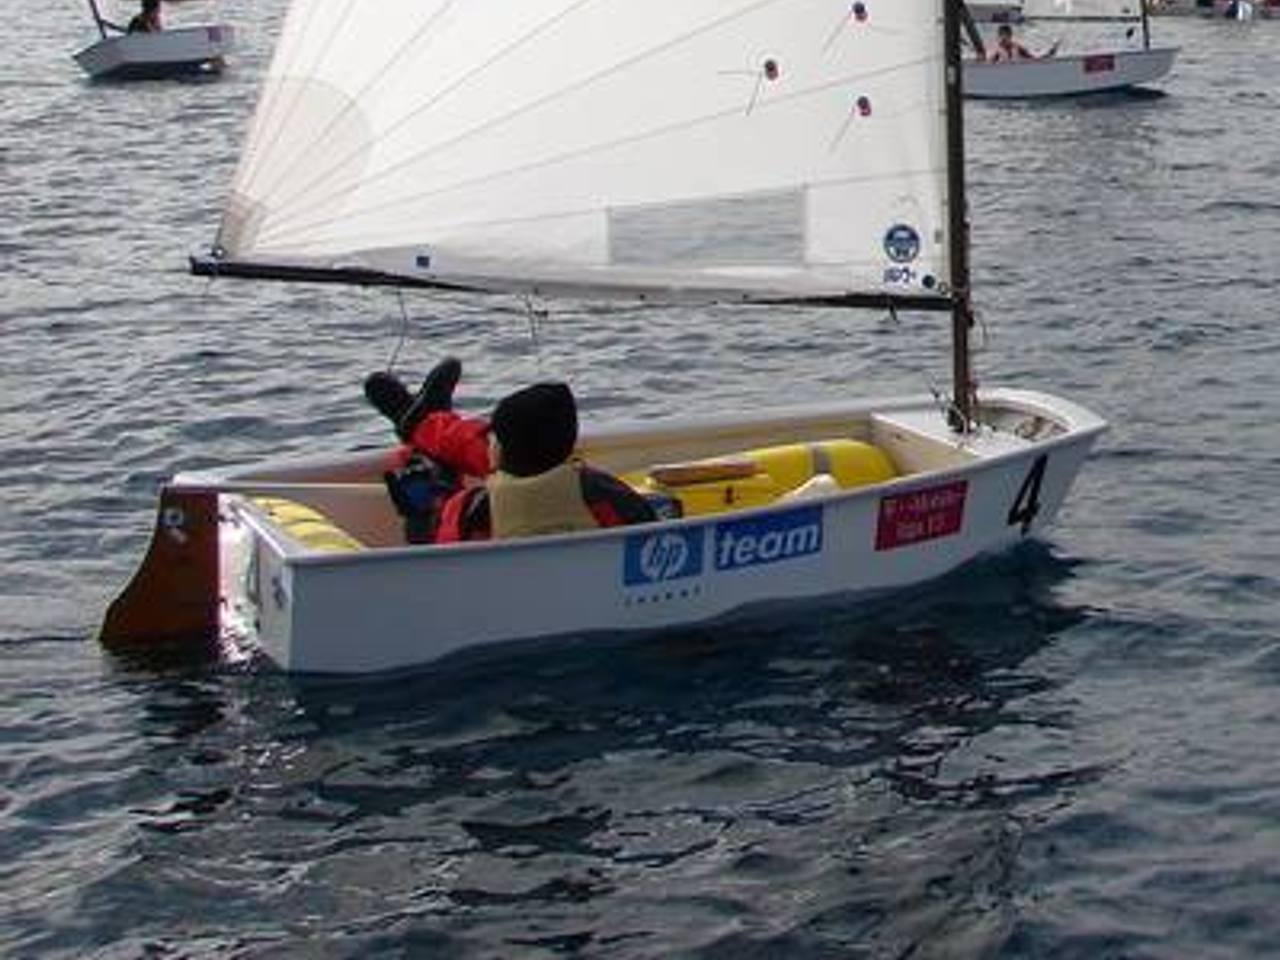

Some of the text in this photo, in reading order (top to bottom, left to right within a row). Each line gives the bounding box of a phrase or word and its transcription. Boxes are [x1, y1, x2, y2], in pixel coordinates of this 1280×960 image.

[1008, 453, 1048, 536] 4
[640, 524, 819, 581] hp team
